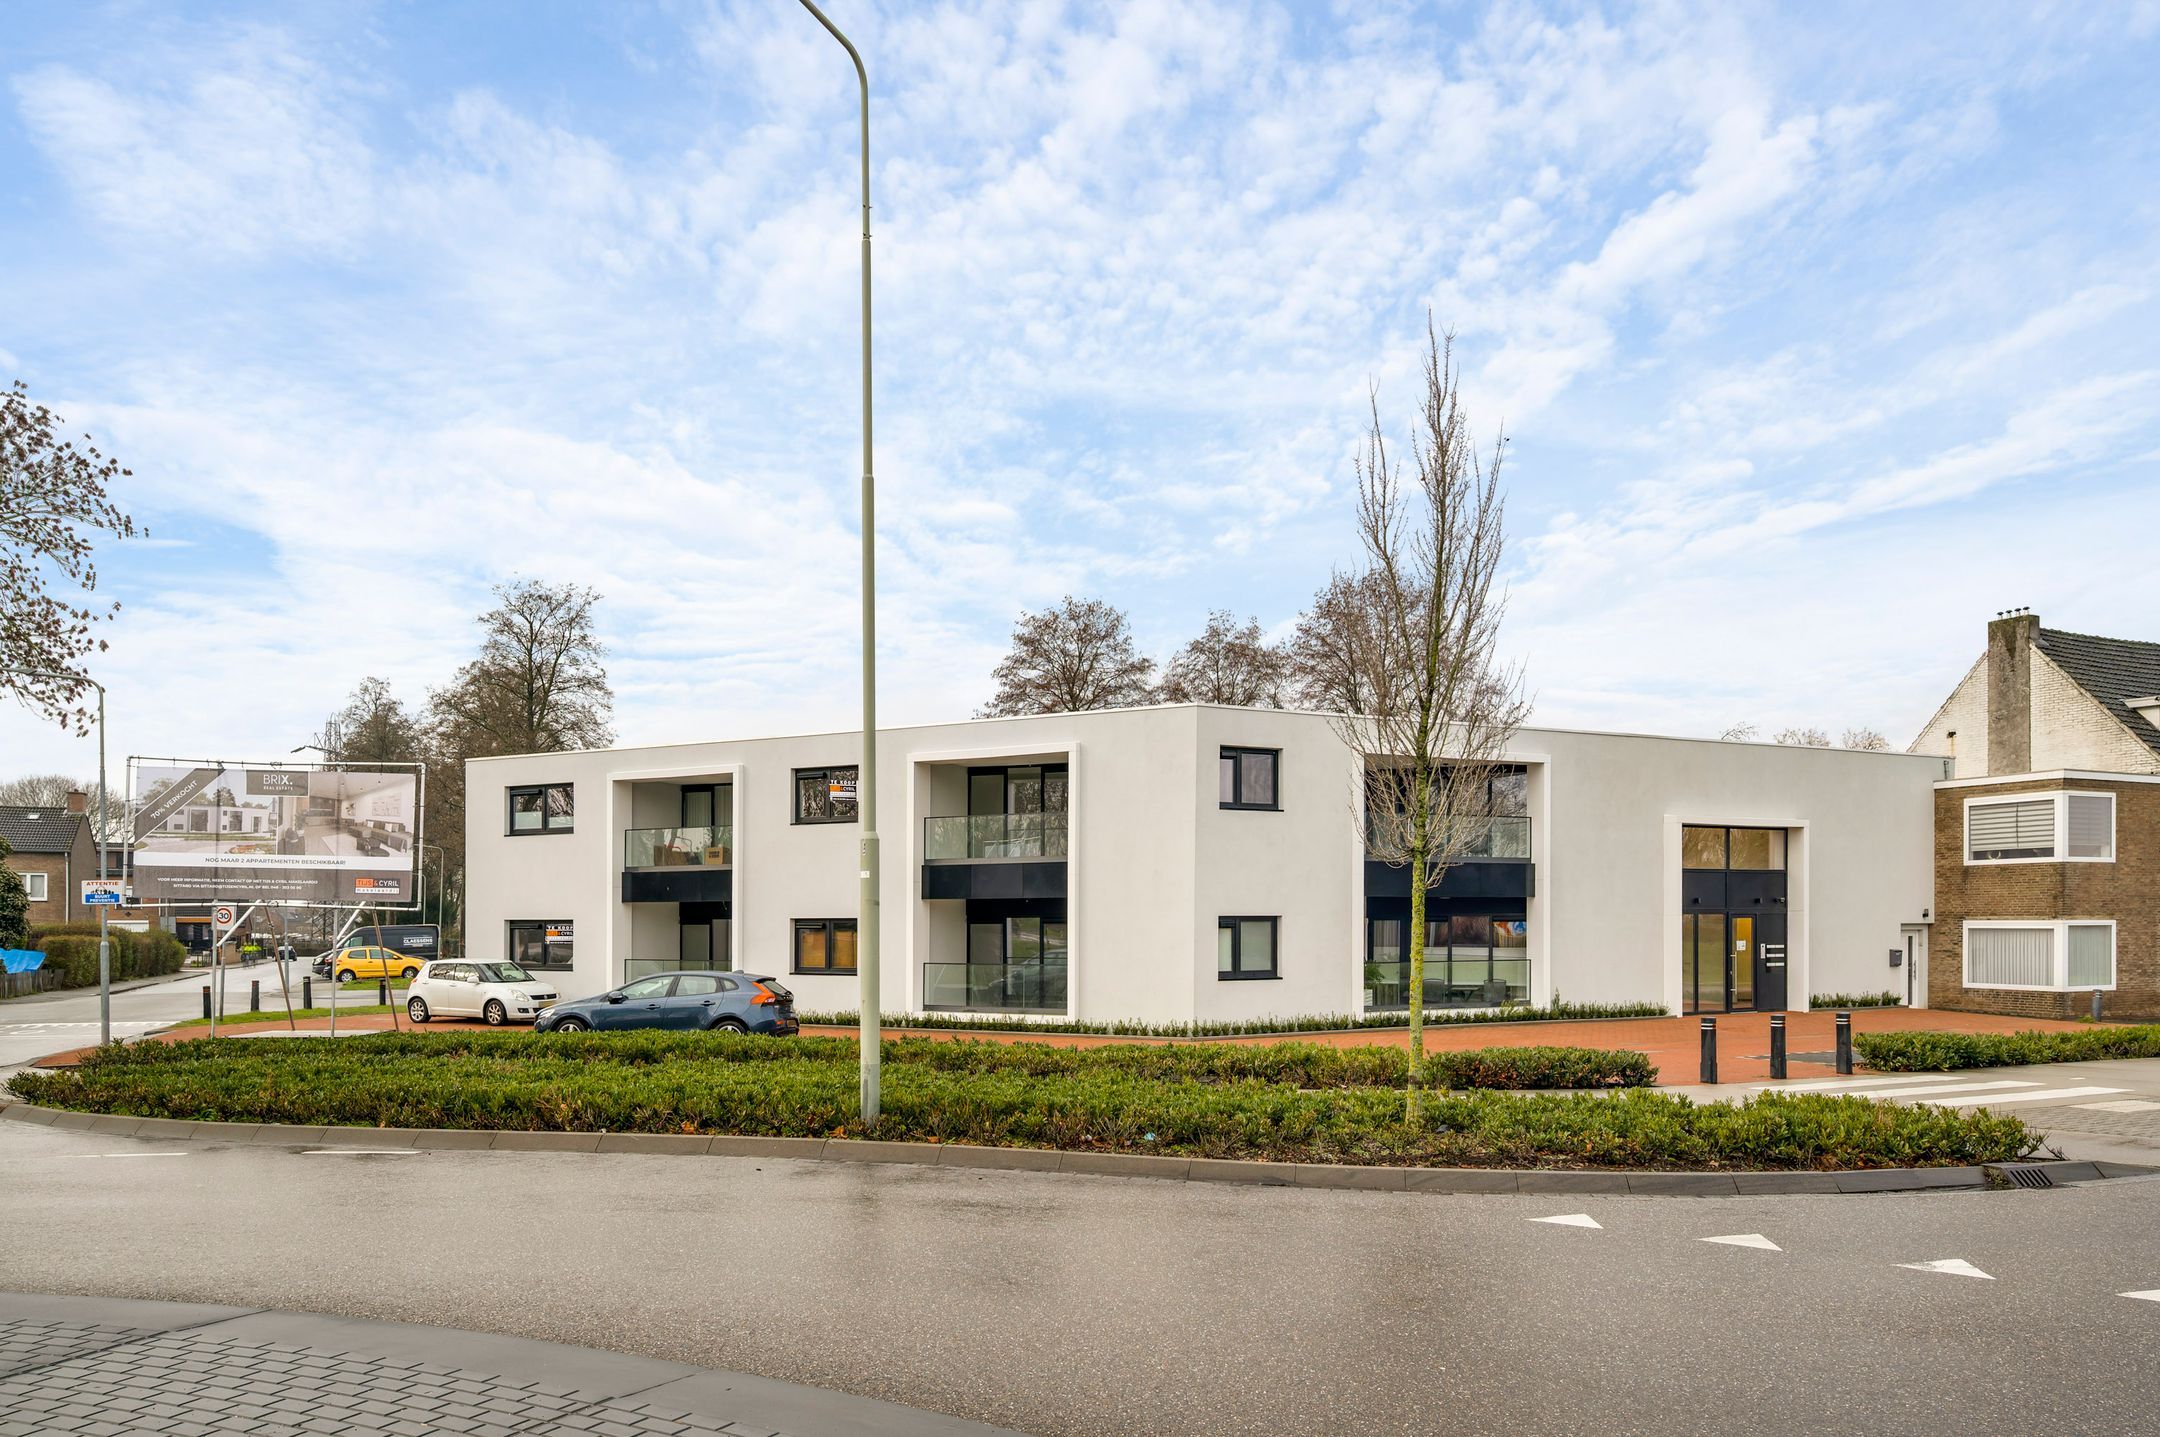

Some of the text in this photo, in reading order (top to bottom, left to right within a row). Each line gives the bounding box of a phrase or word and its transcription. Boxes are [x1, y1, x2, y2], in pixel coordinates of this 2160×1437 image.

[263, 774, 293, 785] BRIX.
[150, 779, 198, 820] 70% VERKOCHT
[218, 912, 229, 920] 30
